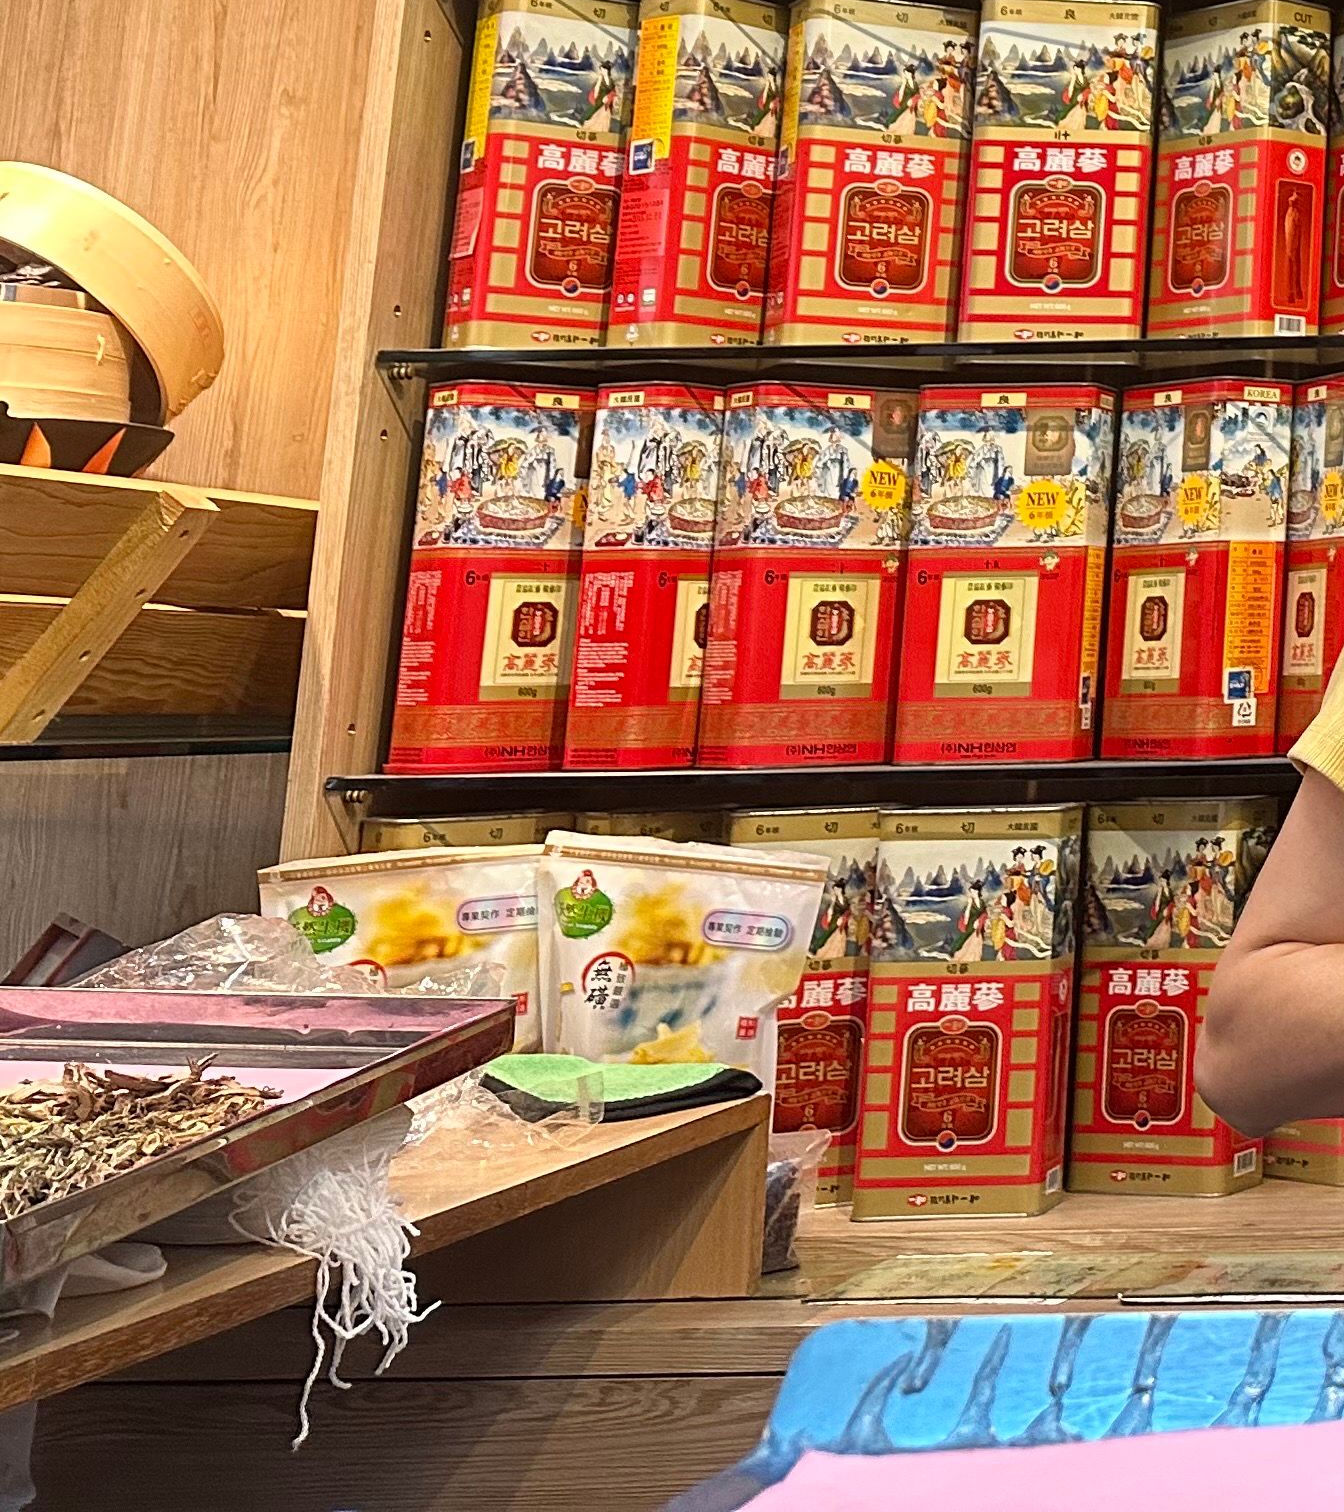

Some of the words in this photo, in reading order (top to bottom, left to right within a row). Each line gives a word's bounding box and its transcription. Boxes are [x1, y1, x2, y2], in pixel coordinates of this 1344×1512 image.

[1294, 12, 1313, 25] CUT
[843, 146, 936, 179] 高麗蔘
[1013, 146, 1107, 173] 高麗蔘
[1174, 149, 1235, 182] 高麗蔘
[847, 220, 922, 246] 고려삼
[1016, 219, 1094, 240] 고려삼
[1176, 220, 1224, 246] 고려삼
[1245, 388, 1280, 402] KOREA
[868, 470, 899, 486] NEW
[1024, 490, 1059, 506] NEW
[1182, 487, 1203, 506] NEW
[1324, 484, 1340, 502] NEW
[824, 821, 839, 834] 切
[960, 821, 975, 834] 切
[1108, 967, 1191, 996] 高麗蔘
[906, 982, 1004, 1013] 高麗蔘
[1111, 1046, 1178, 1070] 고려삼
[775, 1058, 851, 1086] 고려삼
[910, 1065, 990, 1089] 고려삼
